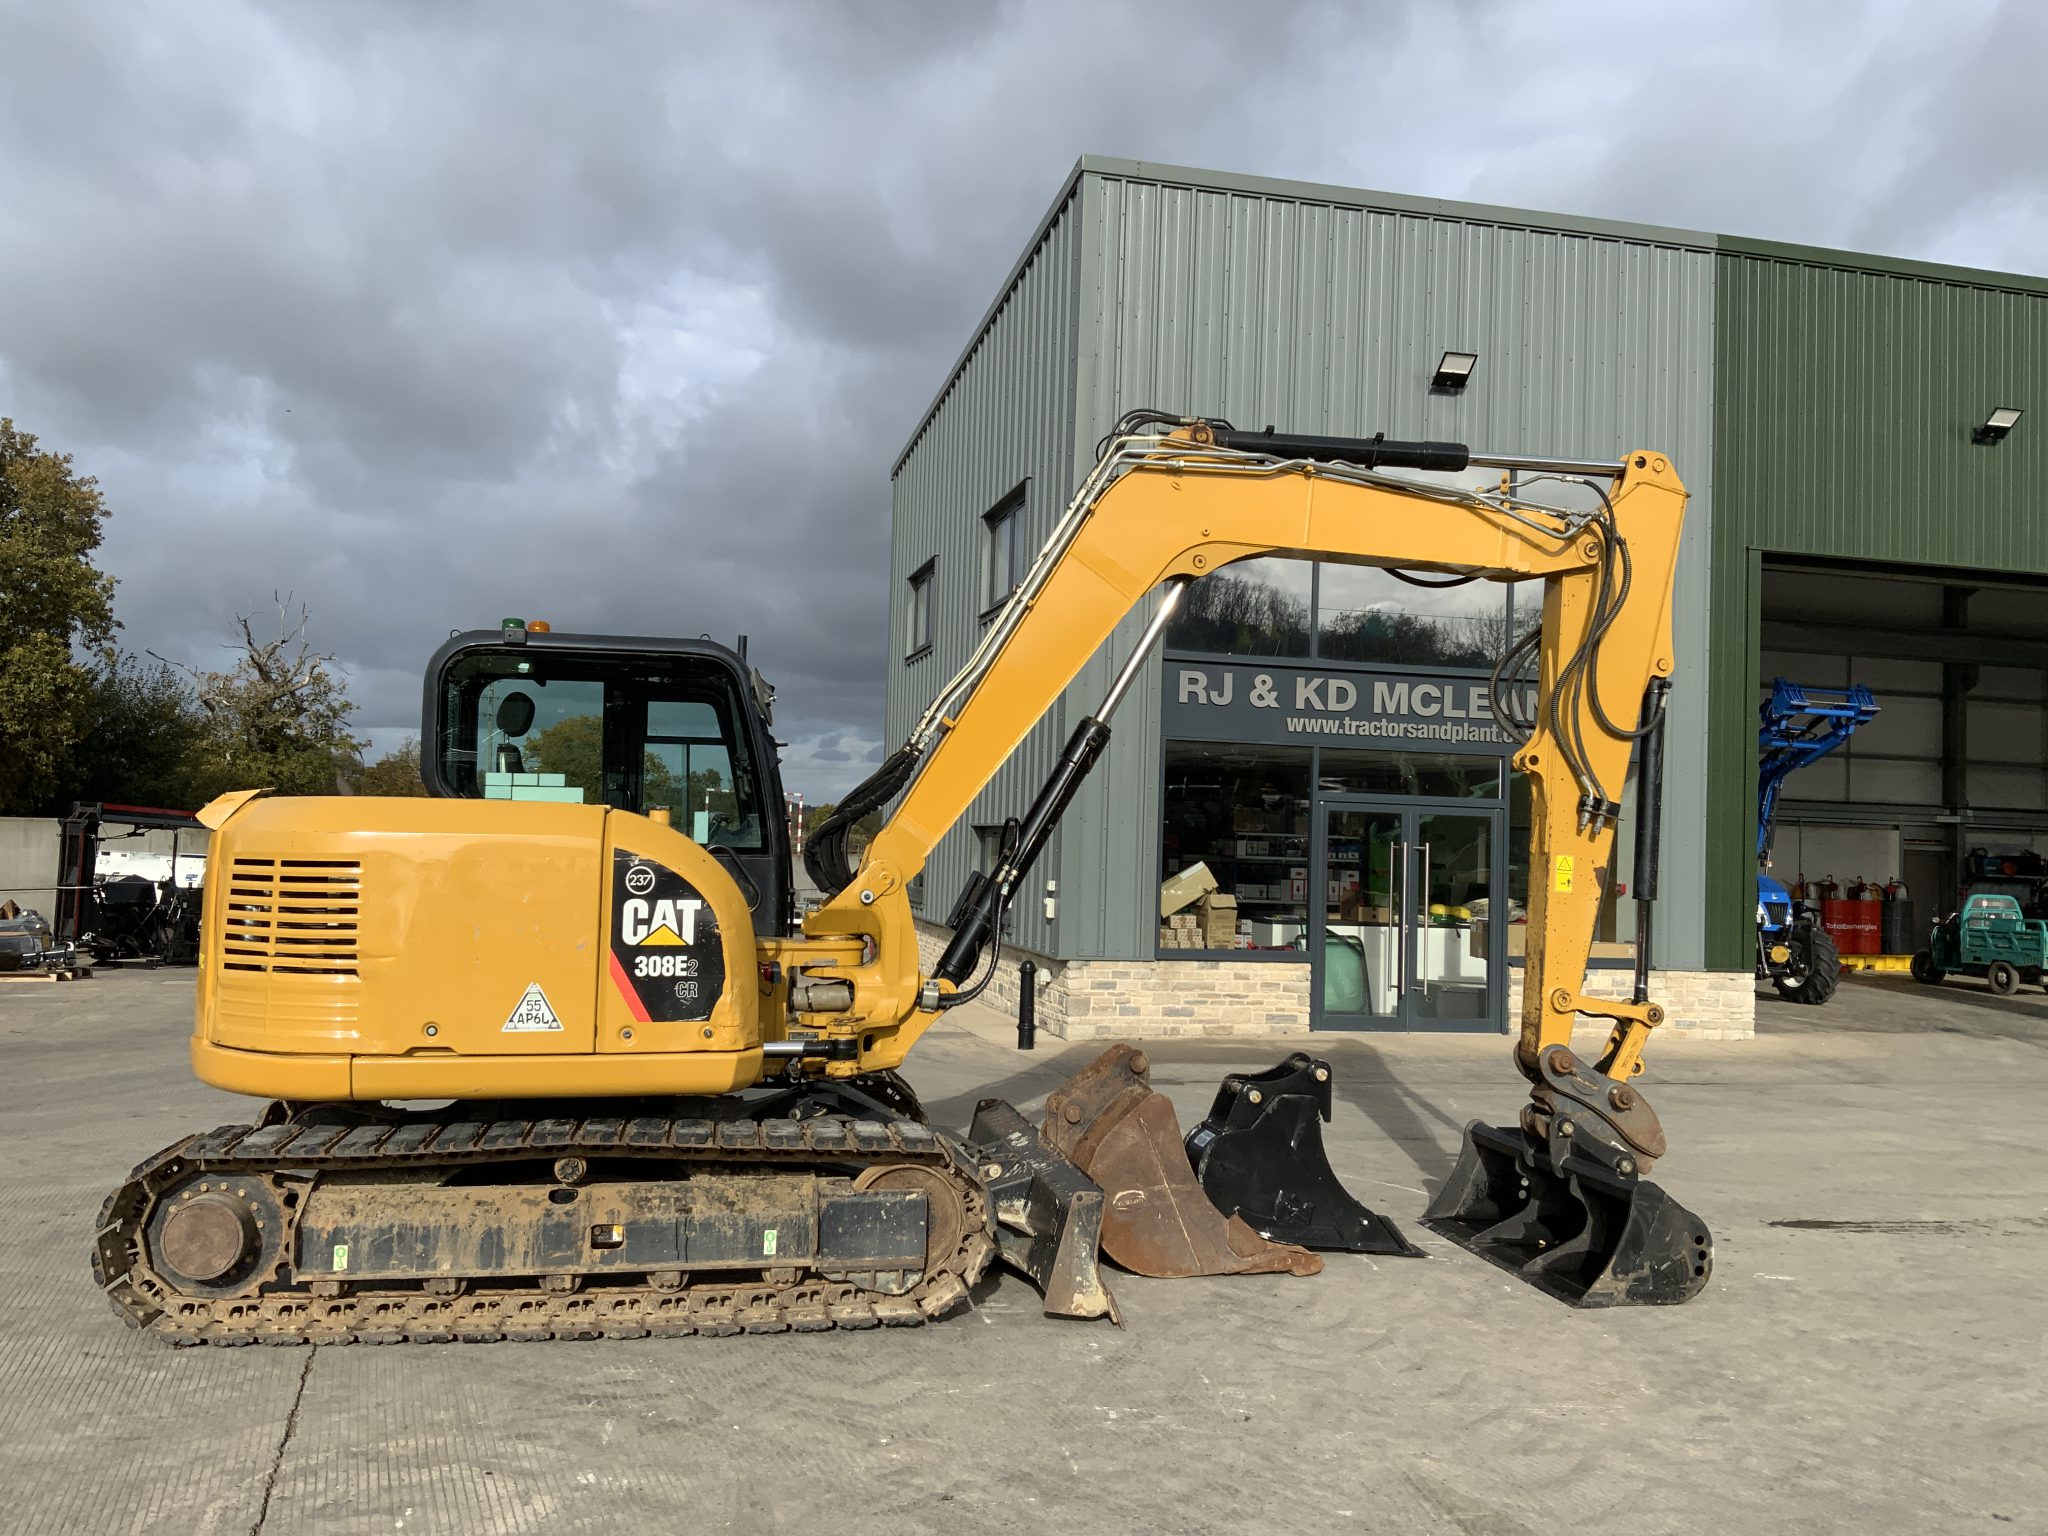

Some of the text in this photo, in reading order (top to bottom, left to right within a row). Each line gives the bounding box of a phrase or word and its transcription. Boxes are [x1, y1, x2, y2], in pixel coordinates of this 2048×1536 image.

[1178, 669, 1233, 705] RJ
[1249, 673, 1280, 708] &
[1295, 677, 1357, 712] KD
[629, 874, 652, 886] 237
[622, 898, 702, 946] CAT
[675, 982, 698, 998] CR
[526, 1000, 542, 1012] 55
[517, 1012, 550, 1025] AP6L
